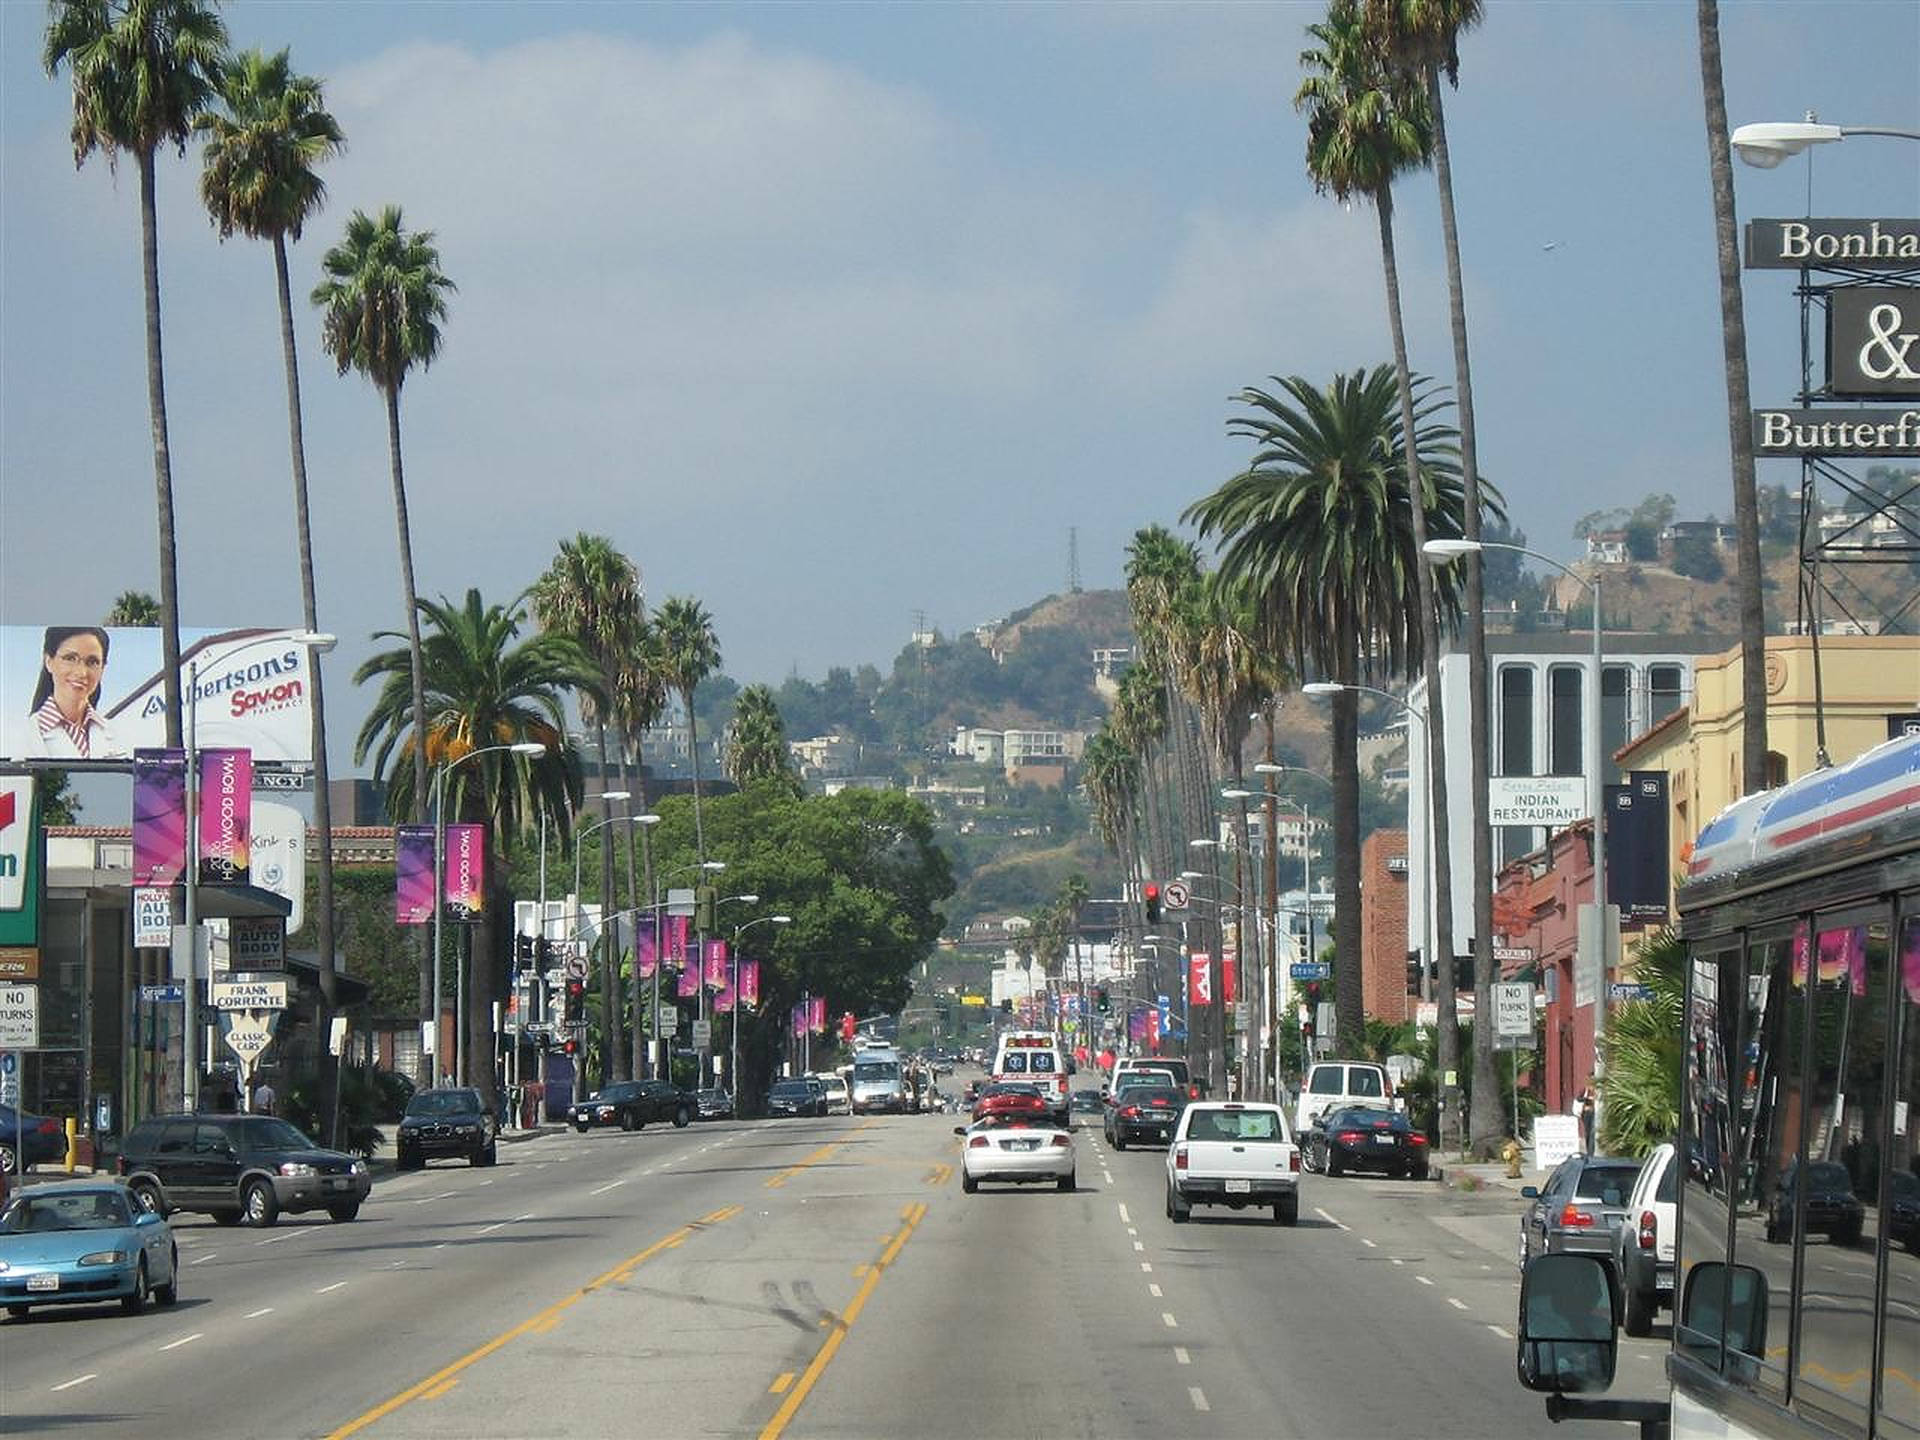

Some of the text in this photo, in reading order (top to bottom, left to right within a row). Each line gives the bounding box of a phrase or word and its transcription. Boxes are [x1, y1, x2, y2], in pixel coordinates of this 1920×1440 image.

[1859, 304, 1920, 379] &
[1514, 795, 1559, 806] INDIAN
[221, 755, 235, 880] HOLLYWOOD BOWL
[1493, 808, 1580, 820] RESTAURANT
[240, 930, 280, 942] AUTO
[240, 942, 280, 954] BODY
[230, 984, 269, 995] FRANK
[1505, 987, 1522, 998] NO
[6, 992, 25, 1005] NO
[217, 995, 283, 1007] CORRENTE
[1500, 1003, 1528, 1013] TURNS
[230, 1031, 265, 1041] CLASSIC
